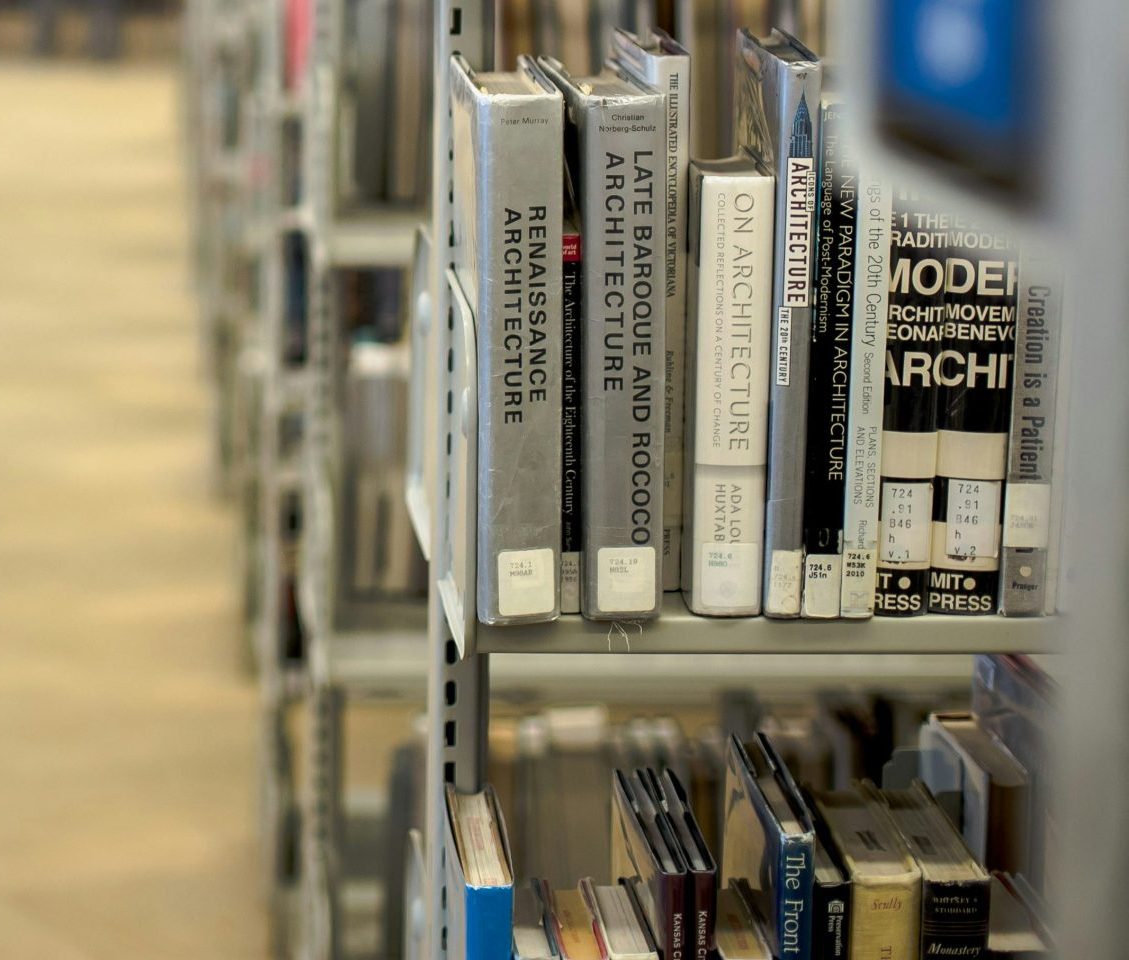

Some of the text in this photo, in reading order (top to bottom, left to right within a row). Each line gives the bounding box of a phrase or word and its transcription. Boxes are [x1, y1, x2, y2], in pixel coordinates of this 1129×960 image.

[669, 72, 679, 91] THE
[500, 117, 549, 126] Peter Murray
[599, 124, 656, 134] Norberg-Schulz
[611, 113, 645, 121] Christian
[668, 93, 679, 153] ILLUSTRATED
[667, 156, 678, 224] ENCYCLOPEDIA
[807, 172, 815, 210] ICONS OF
[820, 160, 836, 216] Language
[840, 175, 855, 219] NEW
[822, 222, 834, 233] of
[869, 208, 884, 222] of
[901, 213, 909, 228] 1
[667, 226, 677, 239] OF
[787, 162, 810, 303] ARCHITECTURE
[868, 228, 884, 250] the
[564, 271, 576, 295] The
[603, 151, 625, 391] ARCHITECTURE
[818, 236, 834, 333] Post-Modernism
[835, 225, 854, 318] PARADIGM
[867, 255, 883, 288] 20th
[504, 207, 523, 425] ARCHITECTURE
[528, 206, 547, 403] RENAISSANCE
[712, 192, 726, 448] COLLECTED REFLECTIONS ON A CENTURY OF CHANGE
[861, 293, 882, 347] Century
[564, 298, 576, 368] Architecture
[728, 193, 755, 451] ON ARCHITECTURE
[834, 323, 850, 341] IN
[631, 150, 653, 546] LATE BAROQUE AND ROCOCO
[778, 308, 790, 383] THE 20th CENTURY
[565, 369, 577, 384] of
[861, 352, 874, 415] Second Edition
[1019, 285, 1052, 481] Creation is a Patient
[565, 385, 576, 403] the
[828, 346, 848, 481] ARCHITECTURE
[563, 406, 577, 467] Eighteenth
[853, 426, 865, 505] AND ELEVATIONS
[562, 469, 577, 515] Century
[730, 483, 742, 514] ADA
[865, 461, 877, 509] SECTIONS
[891, 488, 914, 499] 724
[958, 483, 980, 494] 724
[713, 483, 726, 542] HUXTAB
[891, 504, 913, 515] .91
[956, 515, 979, 526] B46
[958, 499, 980, 510] .91
[858, 520, 868, 549] Richard
[888, 534, 895, 544] h
[955, 530, 962, 541] h
[847, 552, 871, 560] 724.6
[888, 549, 911, 560] v.1
[955, 545, 977, 557] v.2
[809, 563, 832, 572] 724.6
[930, 572, 964, 590] MIT
[929, 592, 992, 612] PRESS
[783, 853, 806, 954] The Front
[673, 912, 683, 949] KANSAS
[698, 910, 708, 946] KANSAS
[927, 942, 982, 958] Monastery
